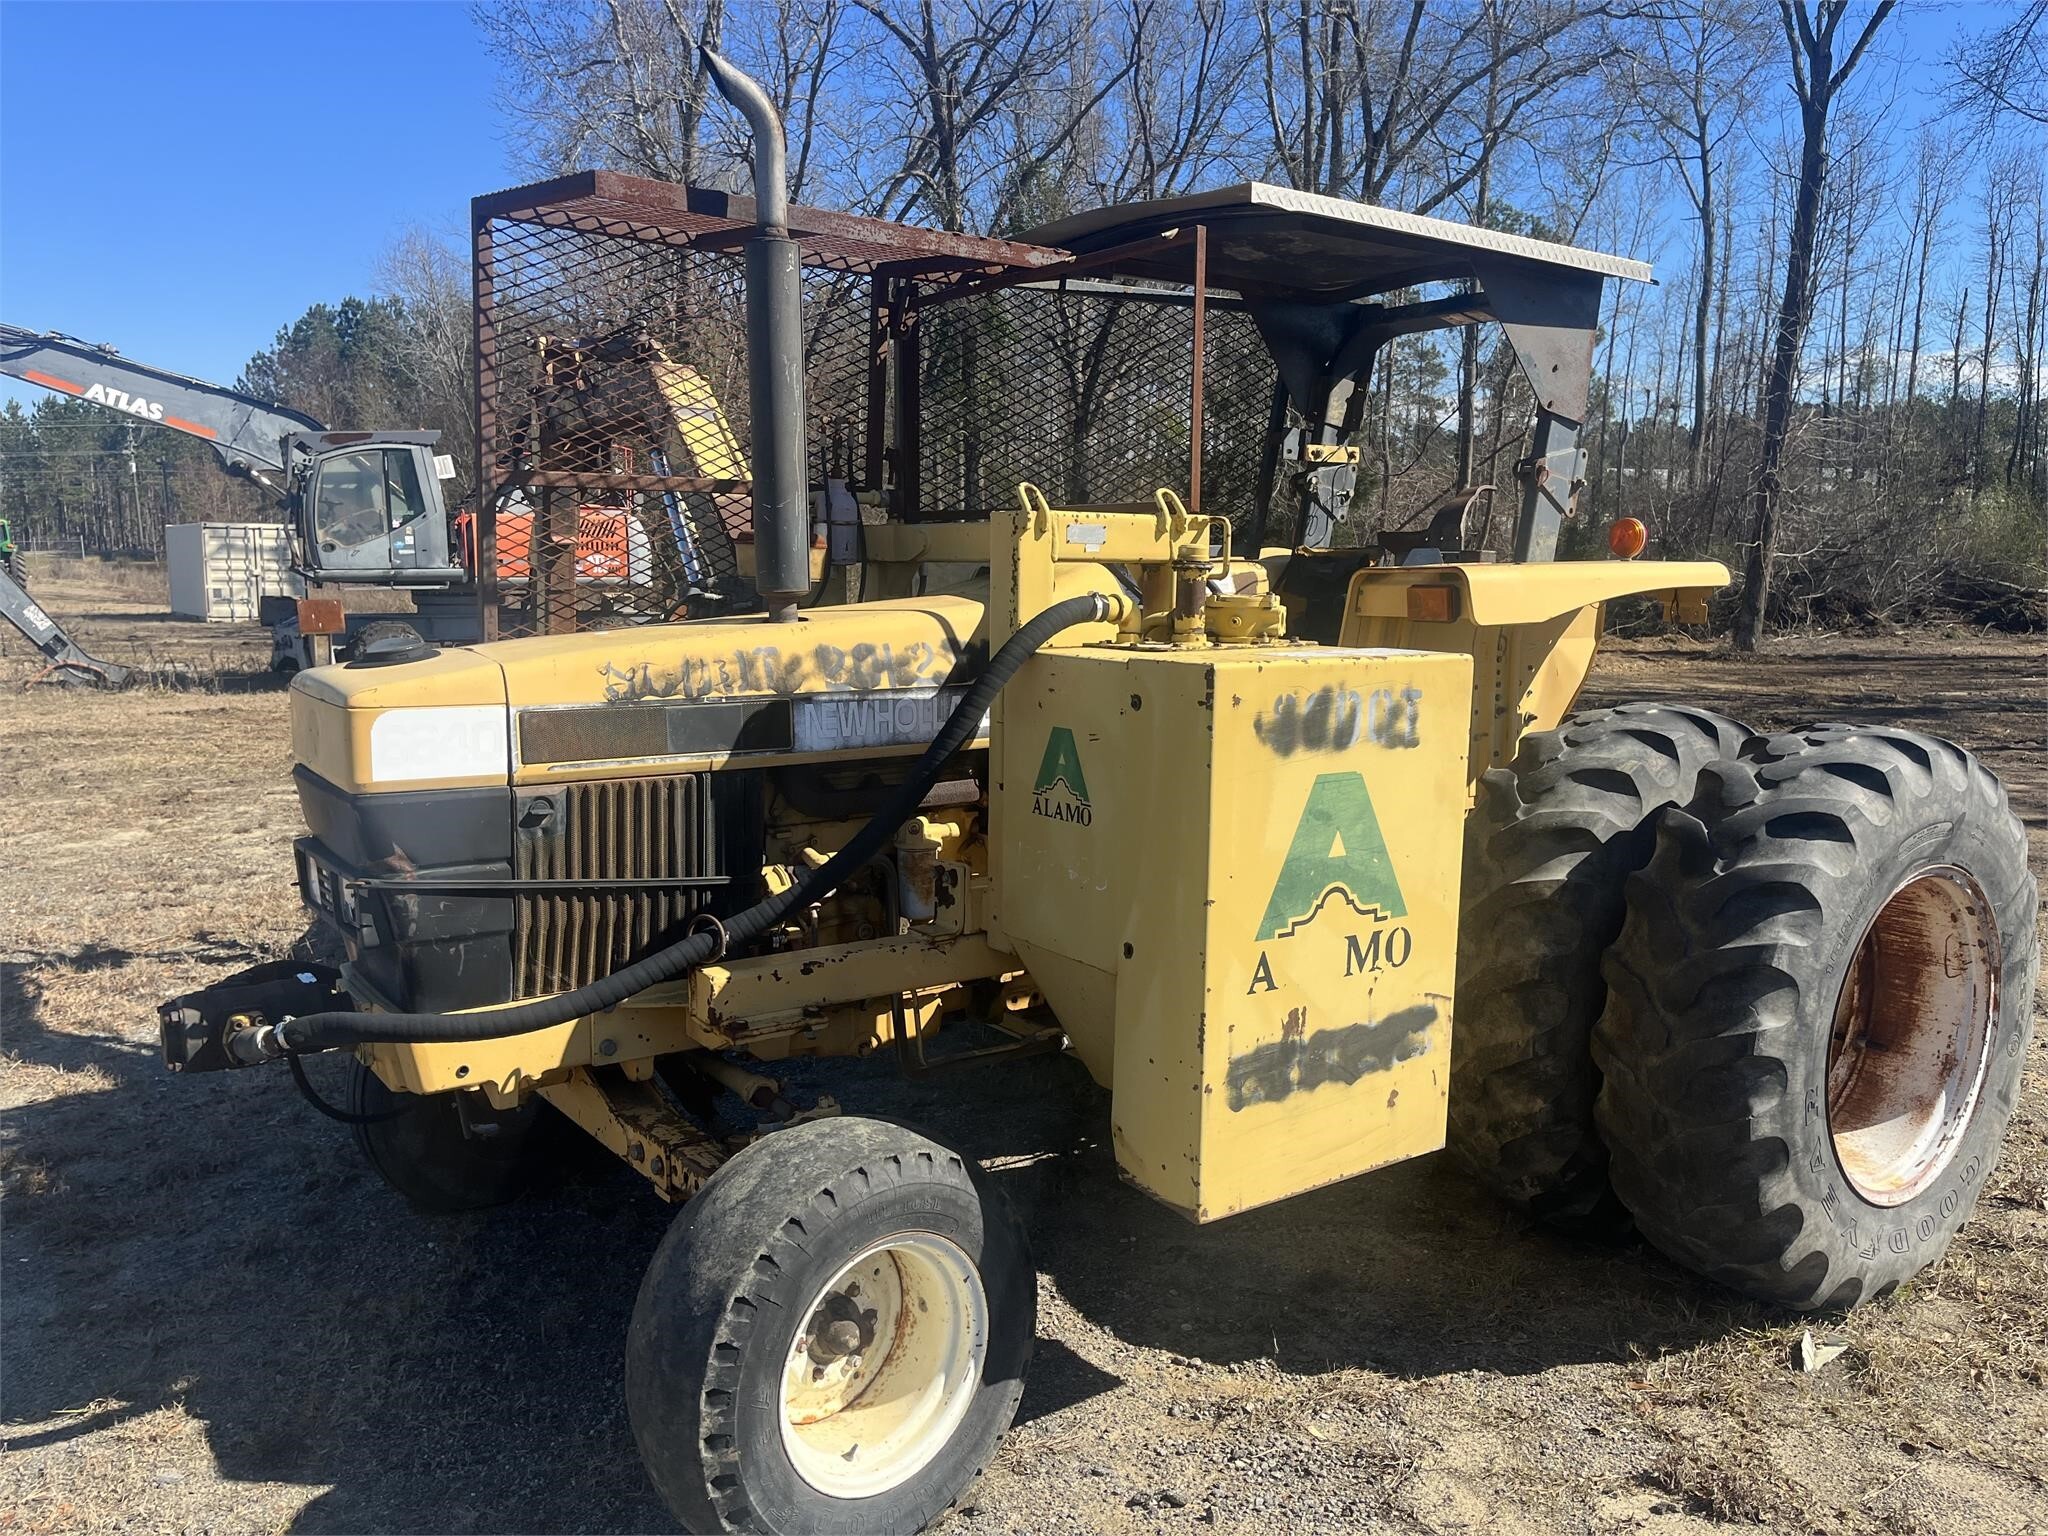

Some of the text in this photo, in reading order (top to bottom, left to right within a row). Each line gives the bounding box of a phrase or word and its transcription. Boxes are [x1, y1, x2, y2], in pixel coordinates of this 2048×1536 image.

[84, 383, 164, 420] ATLAS
[1032, 796, 1092, 827] ALAMO
[1804, 1086, 1981, 1255] GOODYEAR
